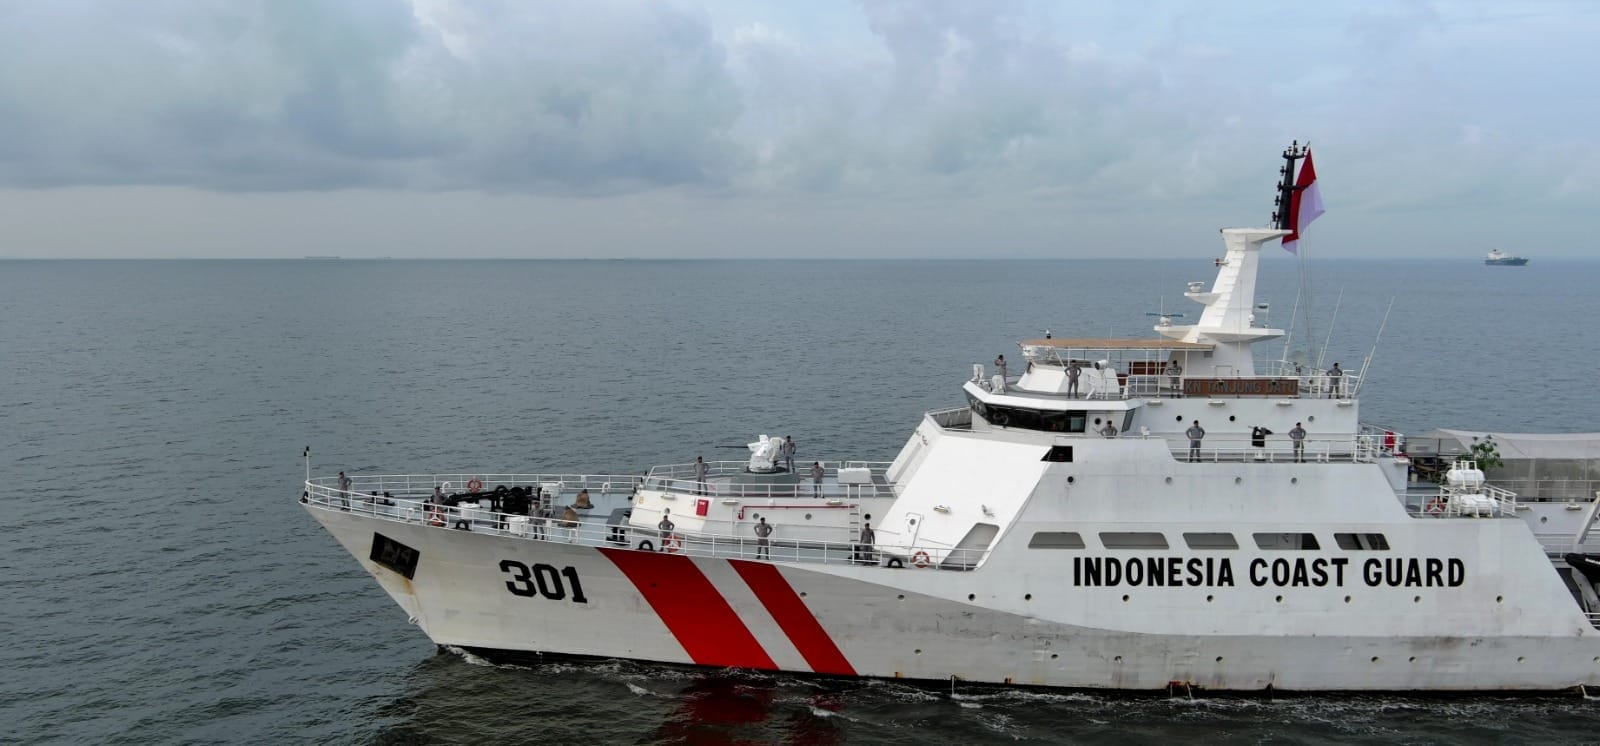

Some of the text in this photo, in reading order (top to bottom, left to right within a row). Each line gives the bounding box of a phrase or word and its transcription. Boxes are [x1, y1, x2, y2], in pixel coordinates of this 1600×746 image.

[1185, 381, 1297, 393] KN TANJUNG DATU
[499, 559, 588, 604] 301
[1073, 557, 1465, 588] INDONESIA COAST GUARD
